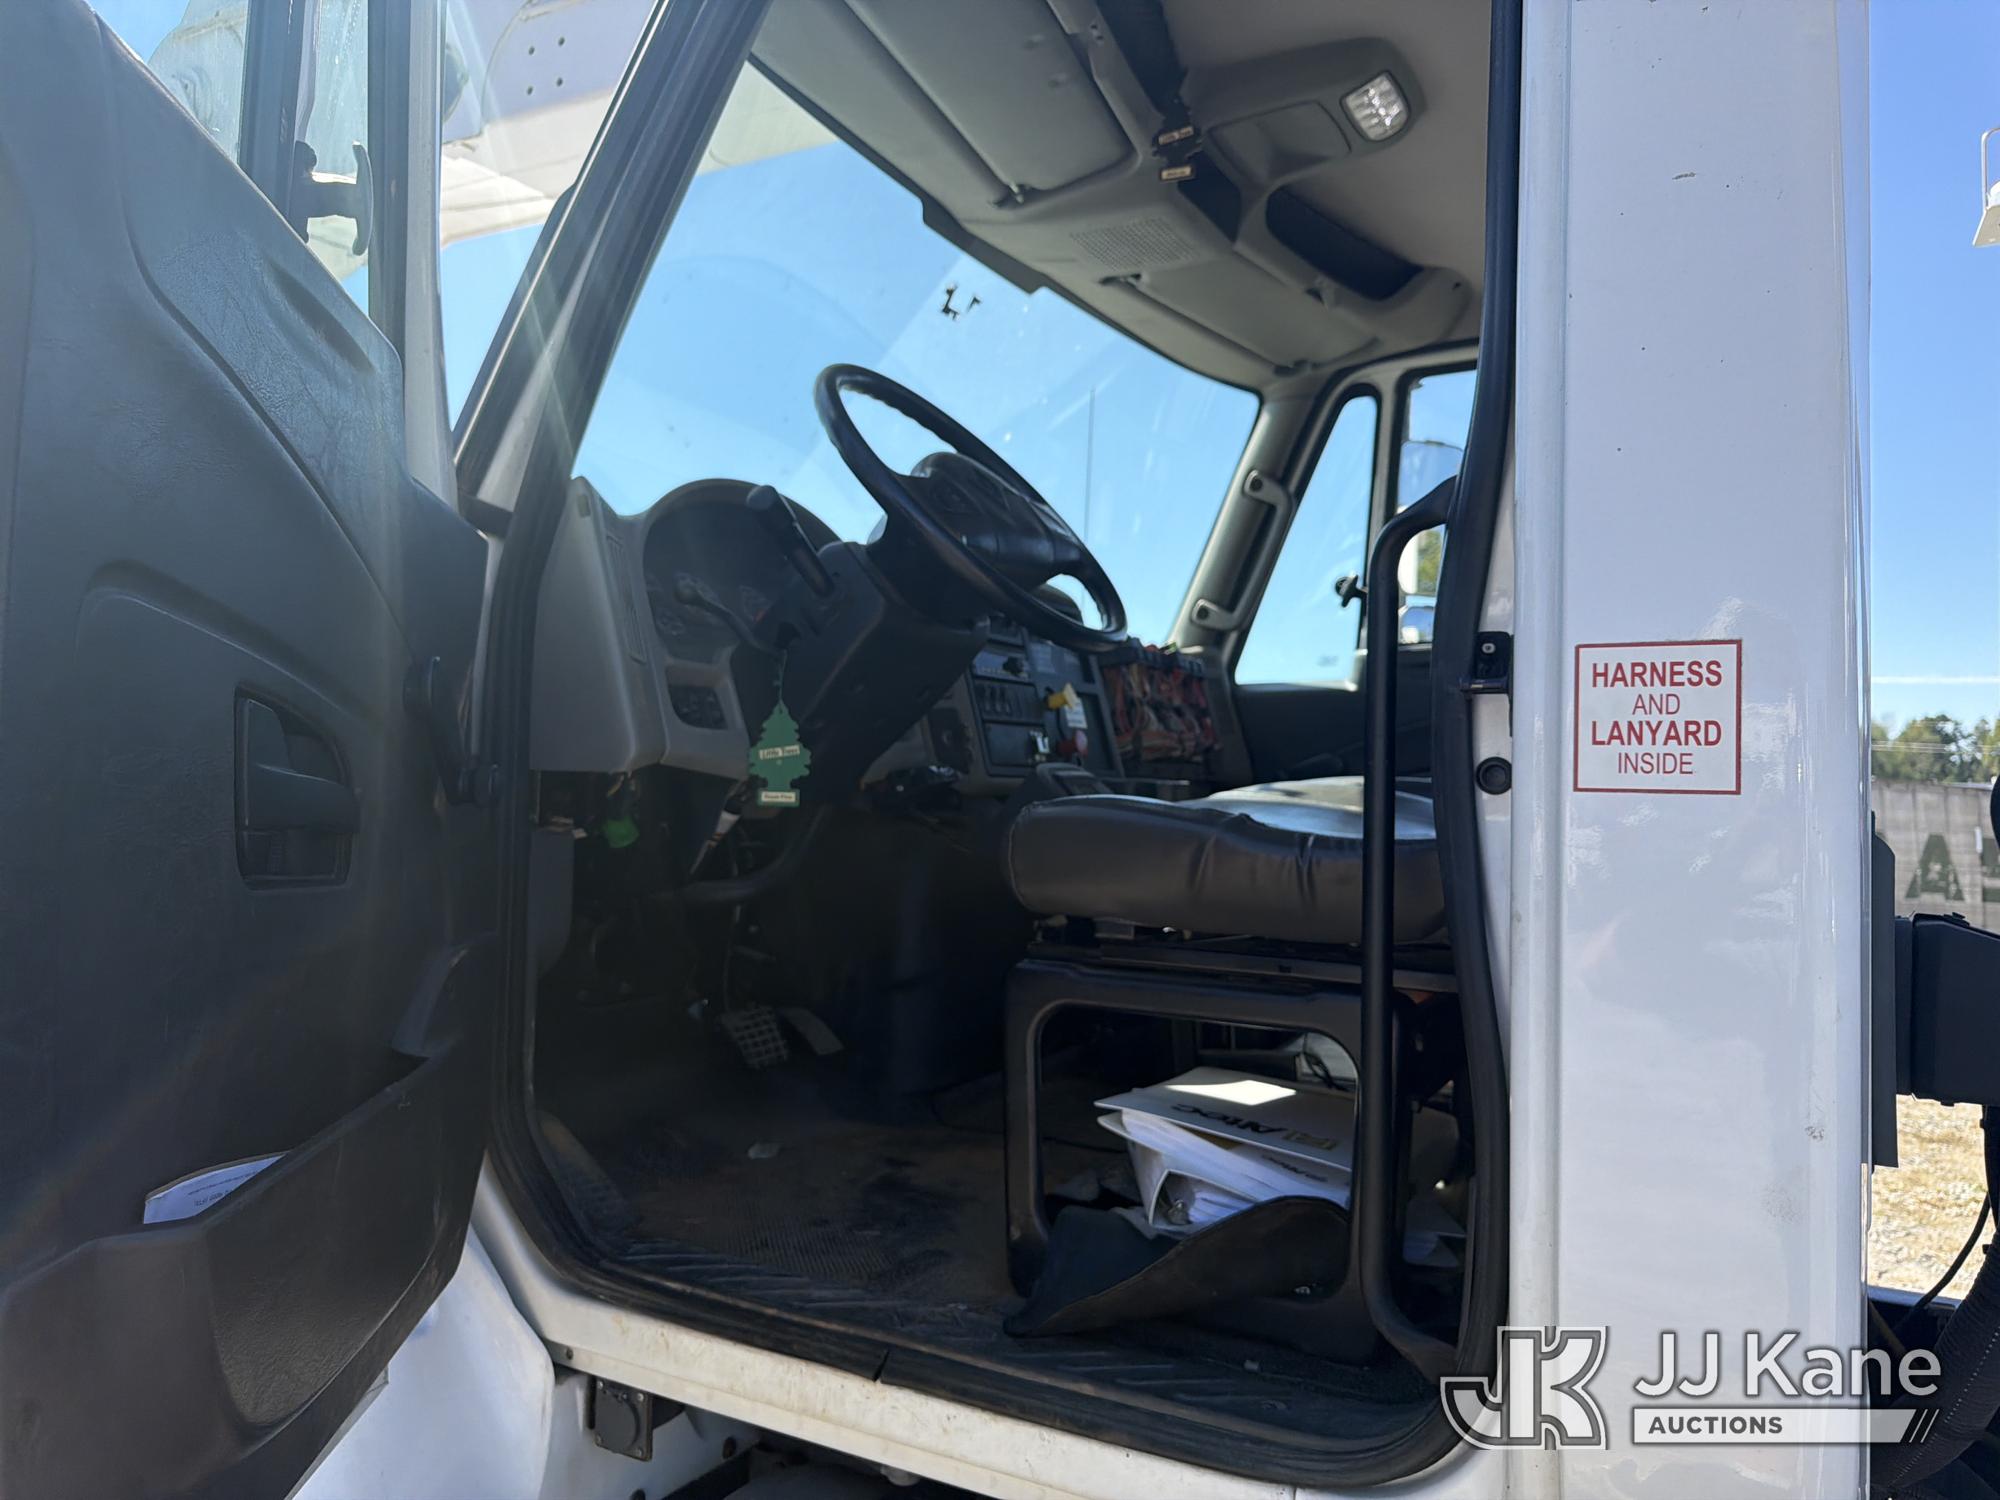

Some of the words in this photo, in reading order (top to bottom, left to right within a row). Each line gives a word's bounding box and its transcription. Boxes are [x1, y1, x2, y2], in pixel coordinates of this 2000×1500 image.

[1592, 660, 1722, 687] HARNESS
[1632, 693, 1680, 715] AND
[1592, 720, 1722, 746] LANYARD
[1618, 752, 1693, 774] INSIDE
